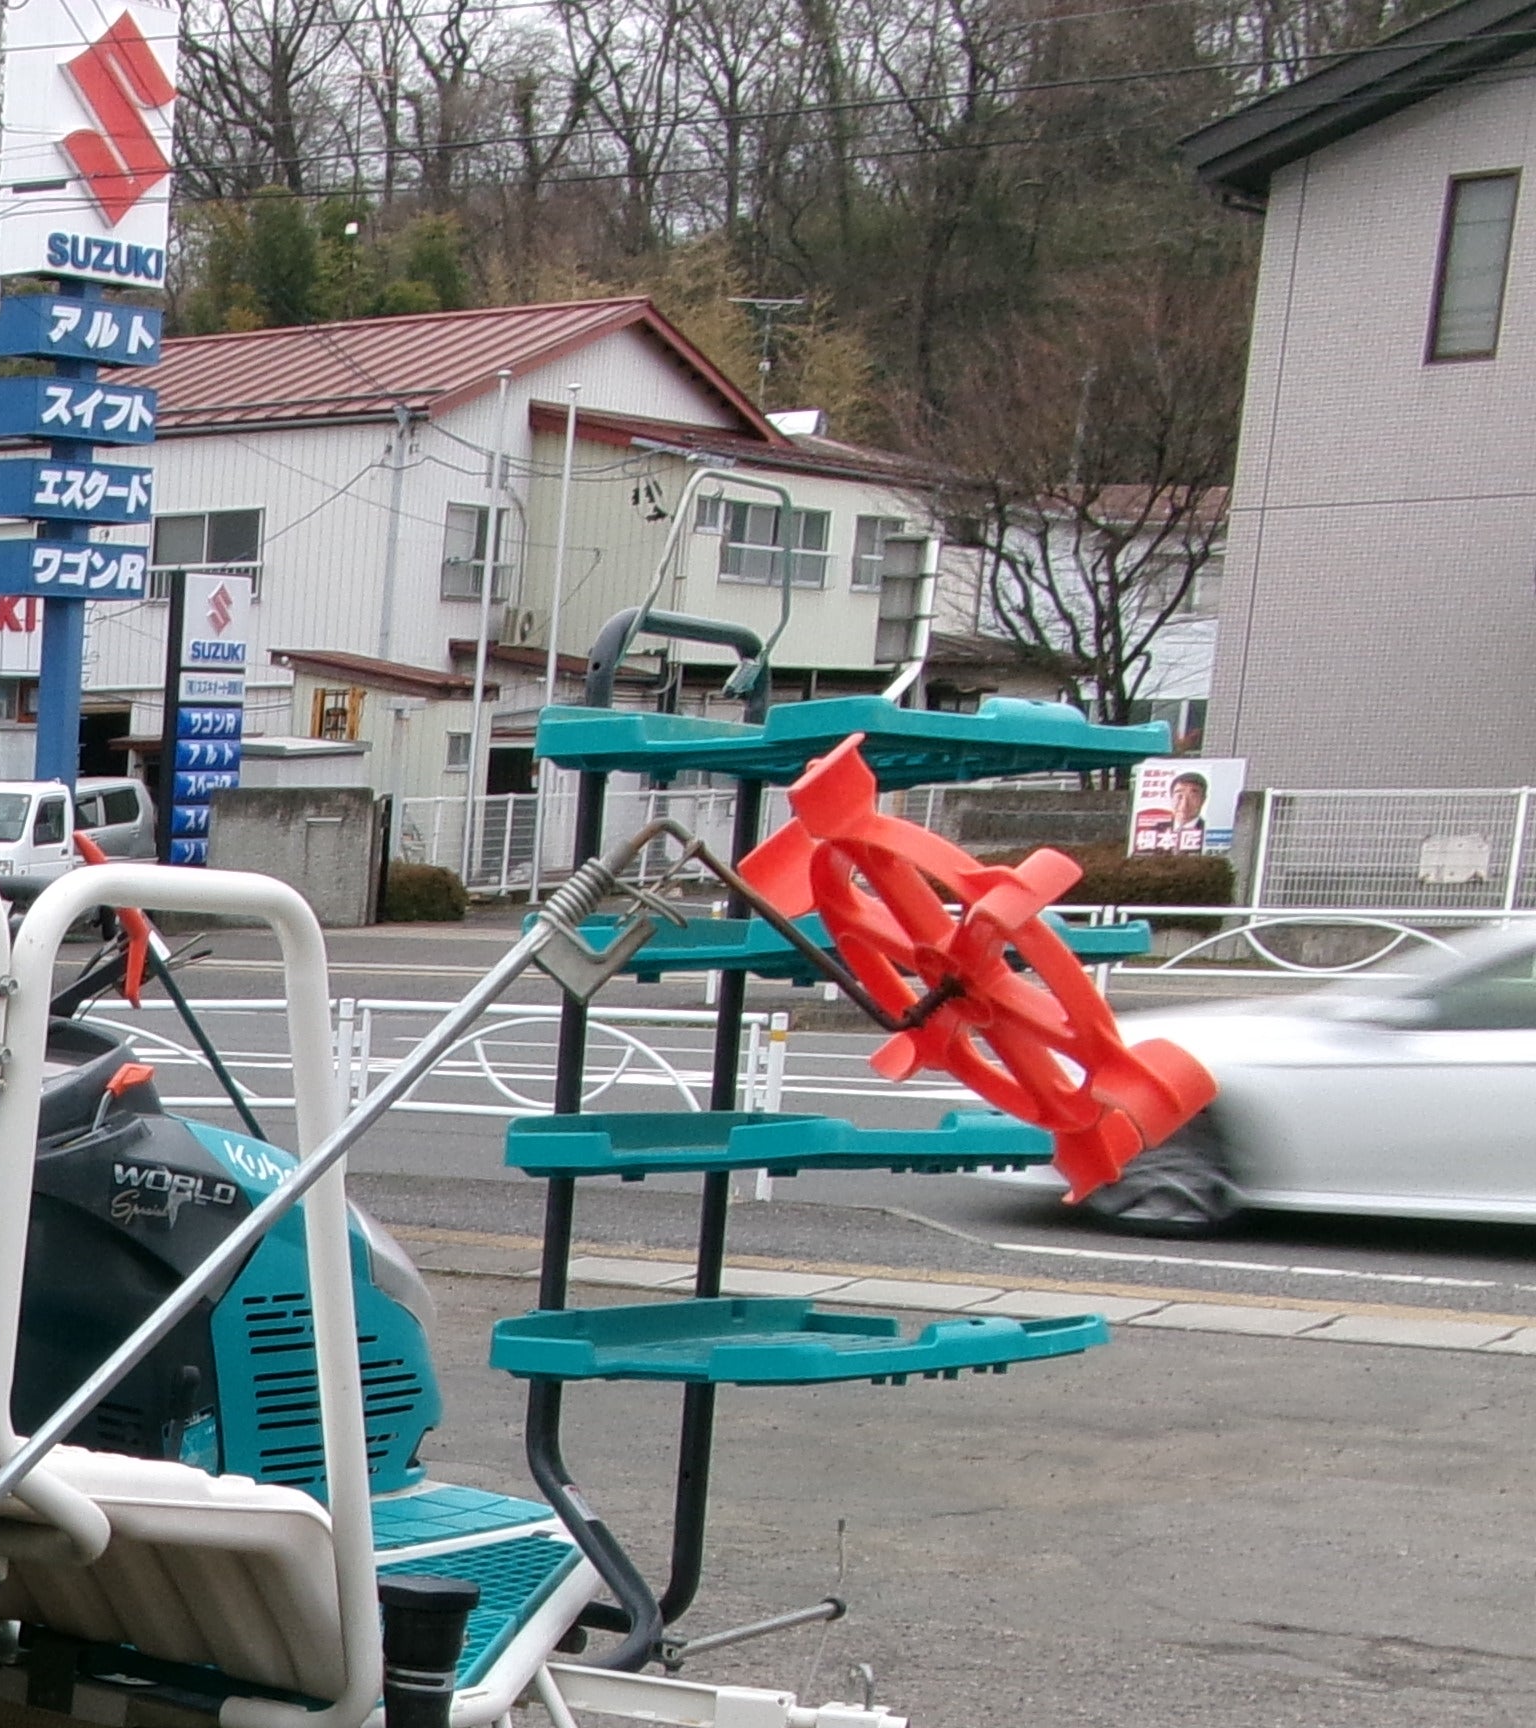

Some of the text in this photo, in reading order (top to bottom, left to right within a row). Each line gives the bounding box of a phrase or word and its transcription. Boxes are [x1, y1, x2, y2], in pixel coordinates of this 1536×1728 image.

[47, 232, 164, 281] SUZUKI
[48, 305, 155, 354] アルト
[41, 386, 153, 432] スイフト
[34, 470, 152, 513] エスクード
[33, 548, 145, 590] ワゴンR
[190, 641, 246, 661] SUZUKI
[190, 711, 236, 735] ワゴンR
[188, 742, 234, 766] アルト
[114, 1163, 236, 1204] WORLD
